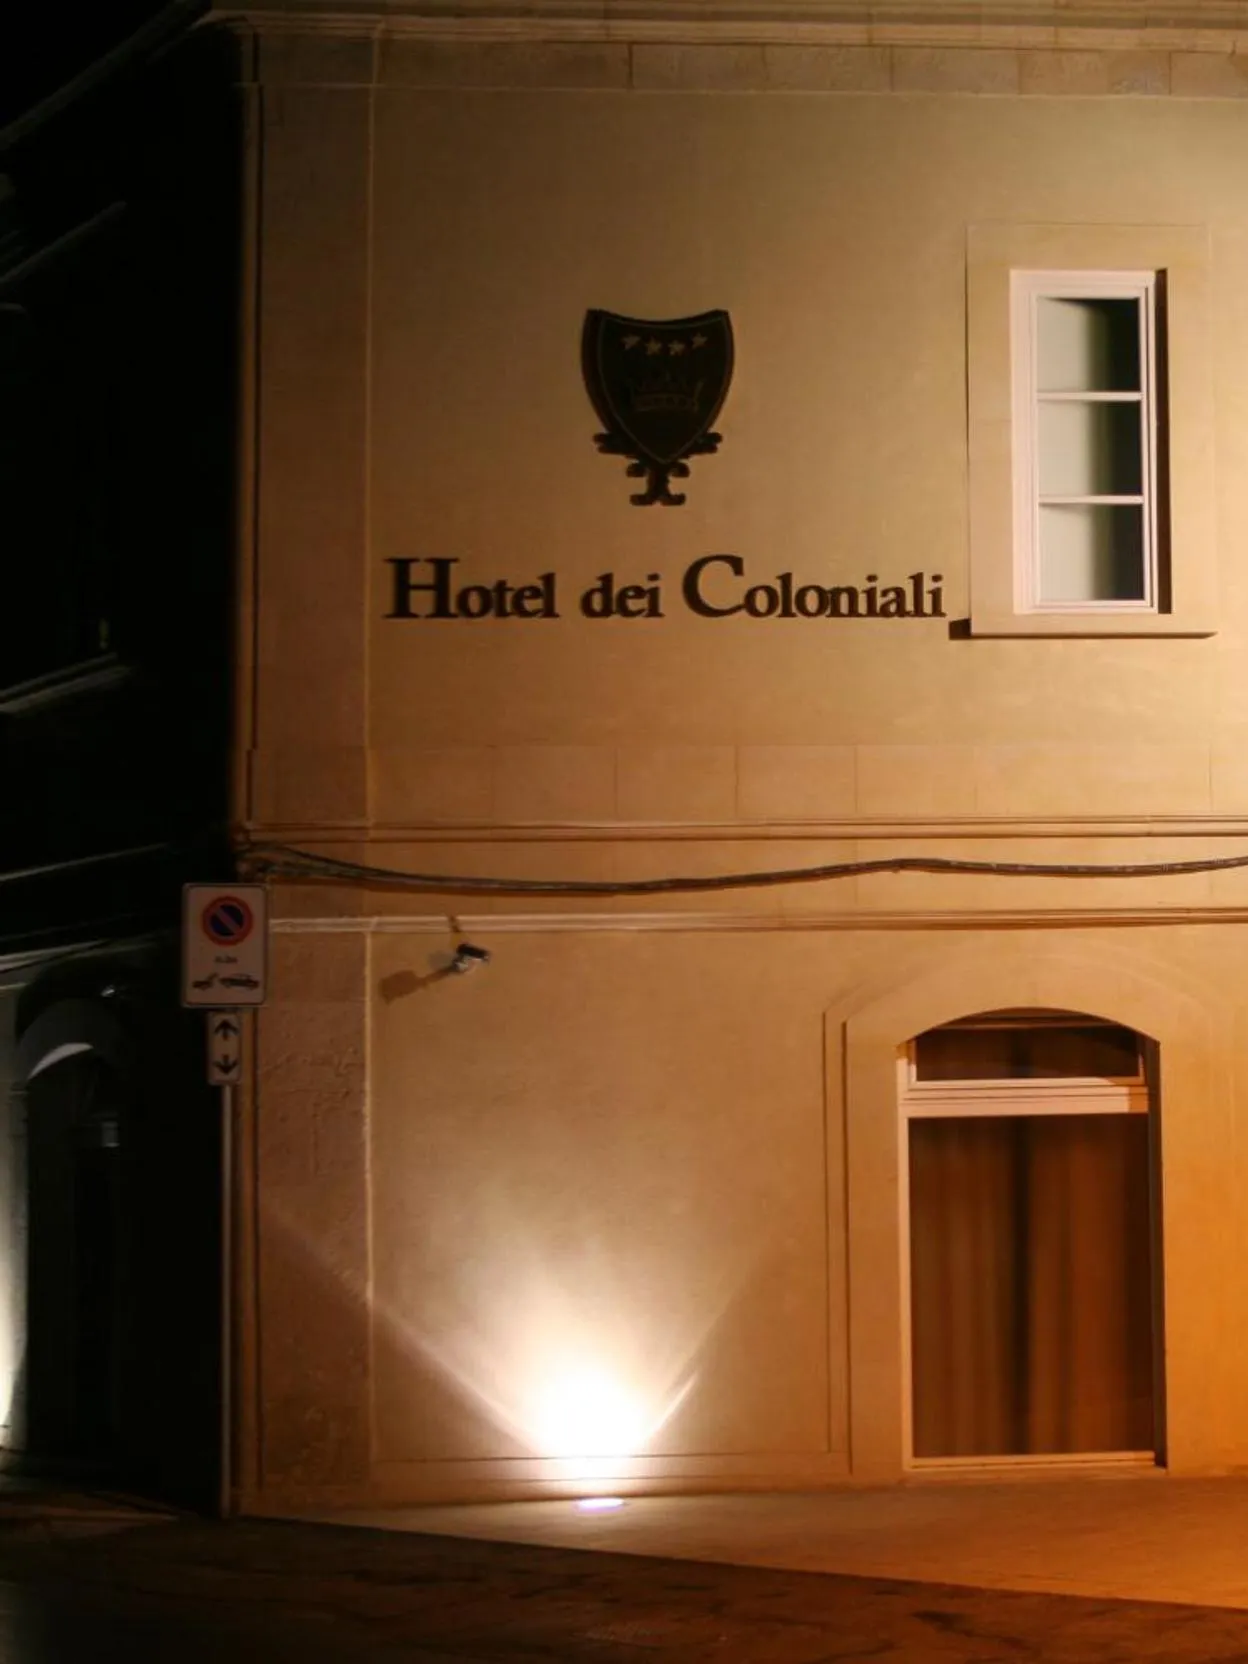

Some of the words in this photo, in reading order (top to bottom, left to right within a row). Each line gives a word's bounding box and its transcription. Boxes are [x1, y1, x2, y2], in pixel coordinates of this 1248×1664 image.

[383, 557, 560, 618] Hotel
[580, 572, 664, 618] dei
[682, 554, 946, 618] Coloniali
